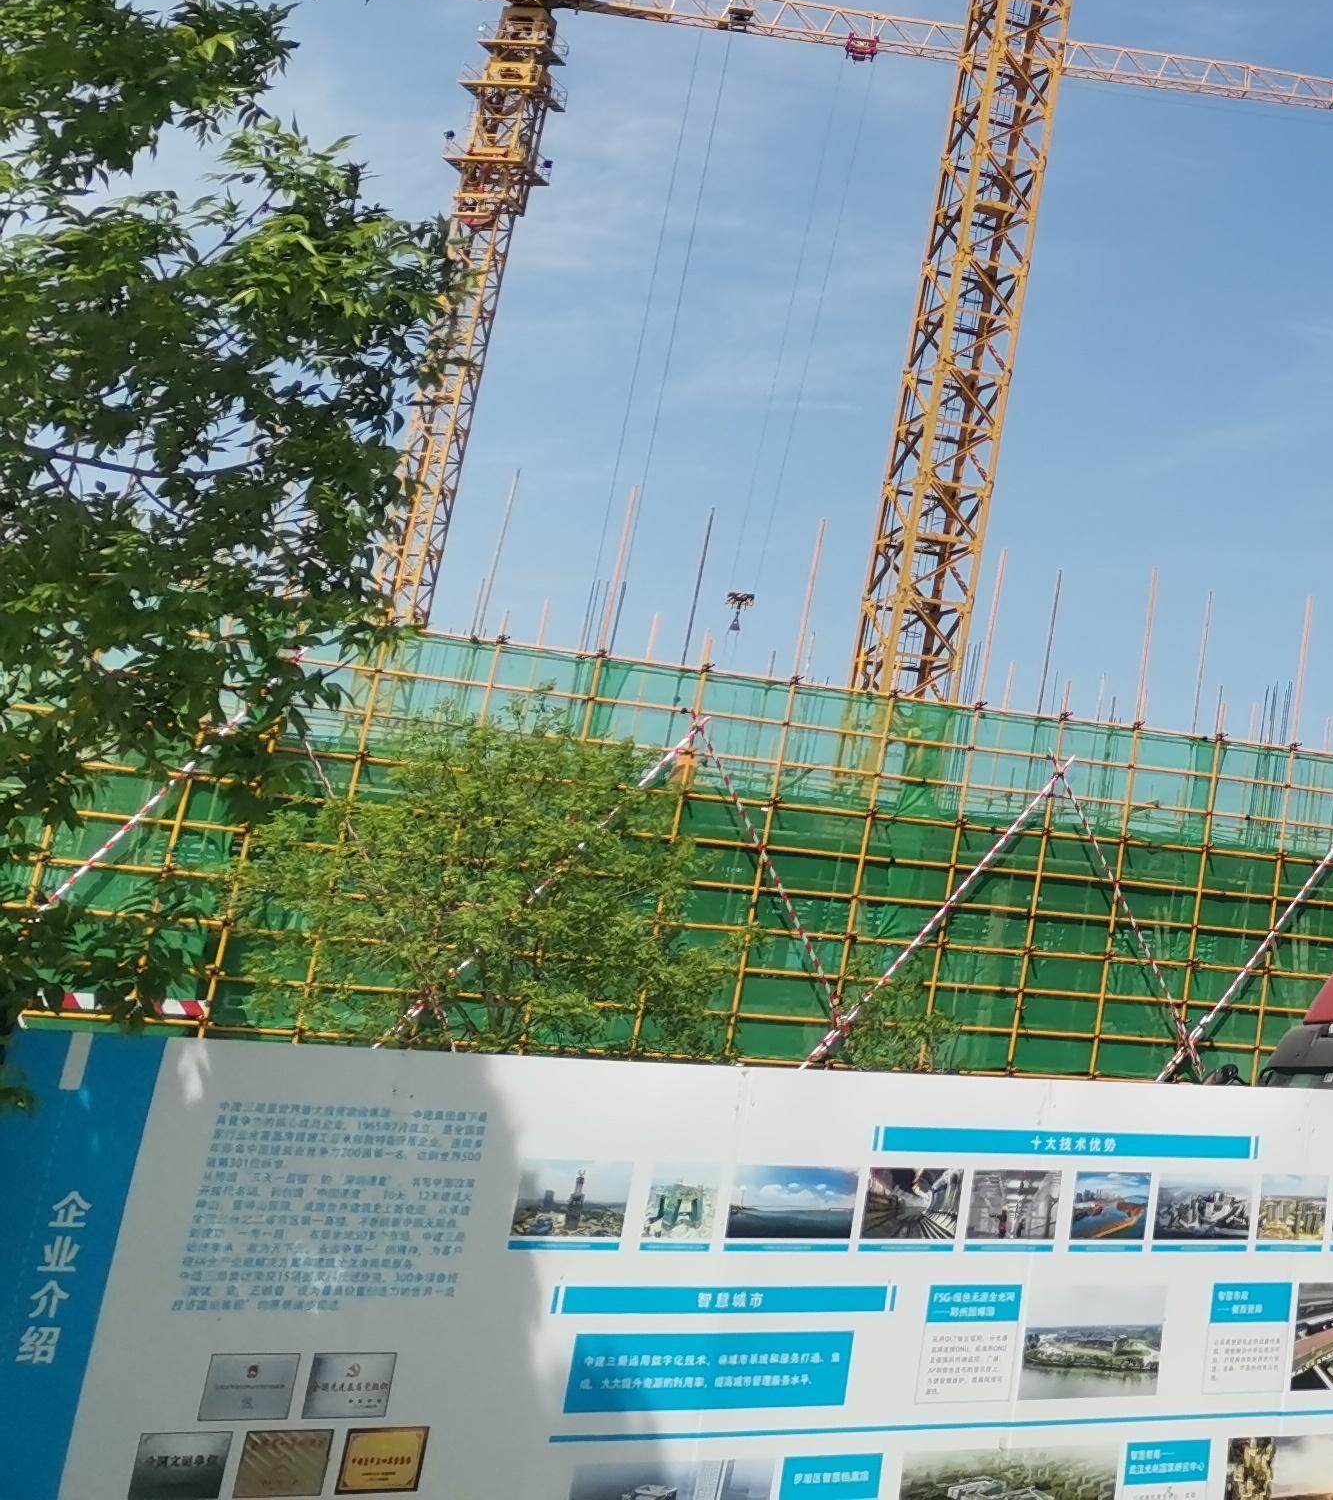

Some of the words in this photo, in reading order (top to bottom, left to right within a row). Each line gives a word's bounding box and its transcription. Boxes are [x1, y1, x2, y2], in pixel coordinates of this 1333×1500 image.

[1029, 1134, 1117, 1153] 十大技术优势
[15, 1190, 93, 1364] 企业介绍
[697, 1292, 766, 1309] 智慧城市
